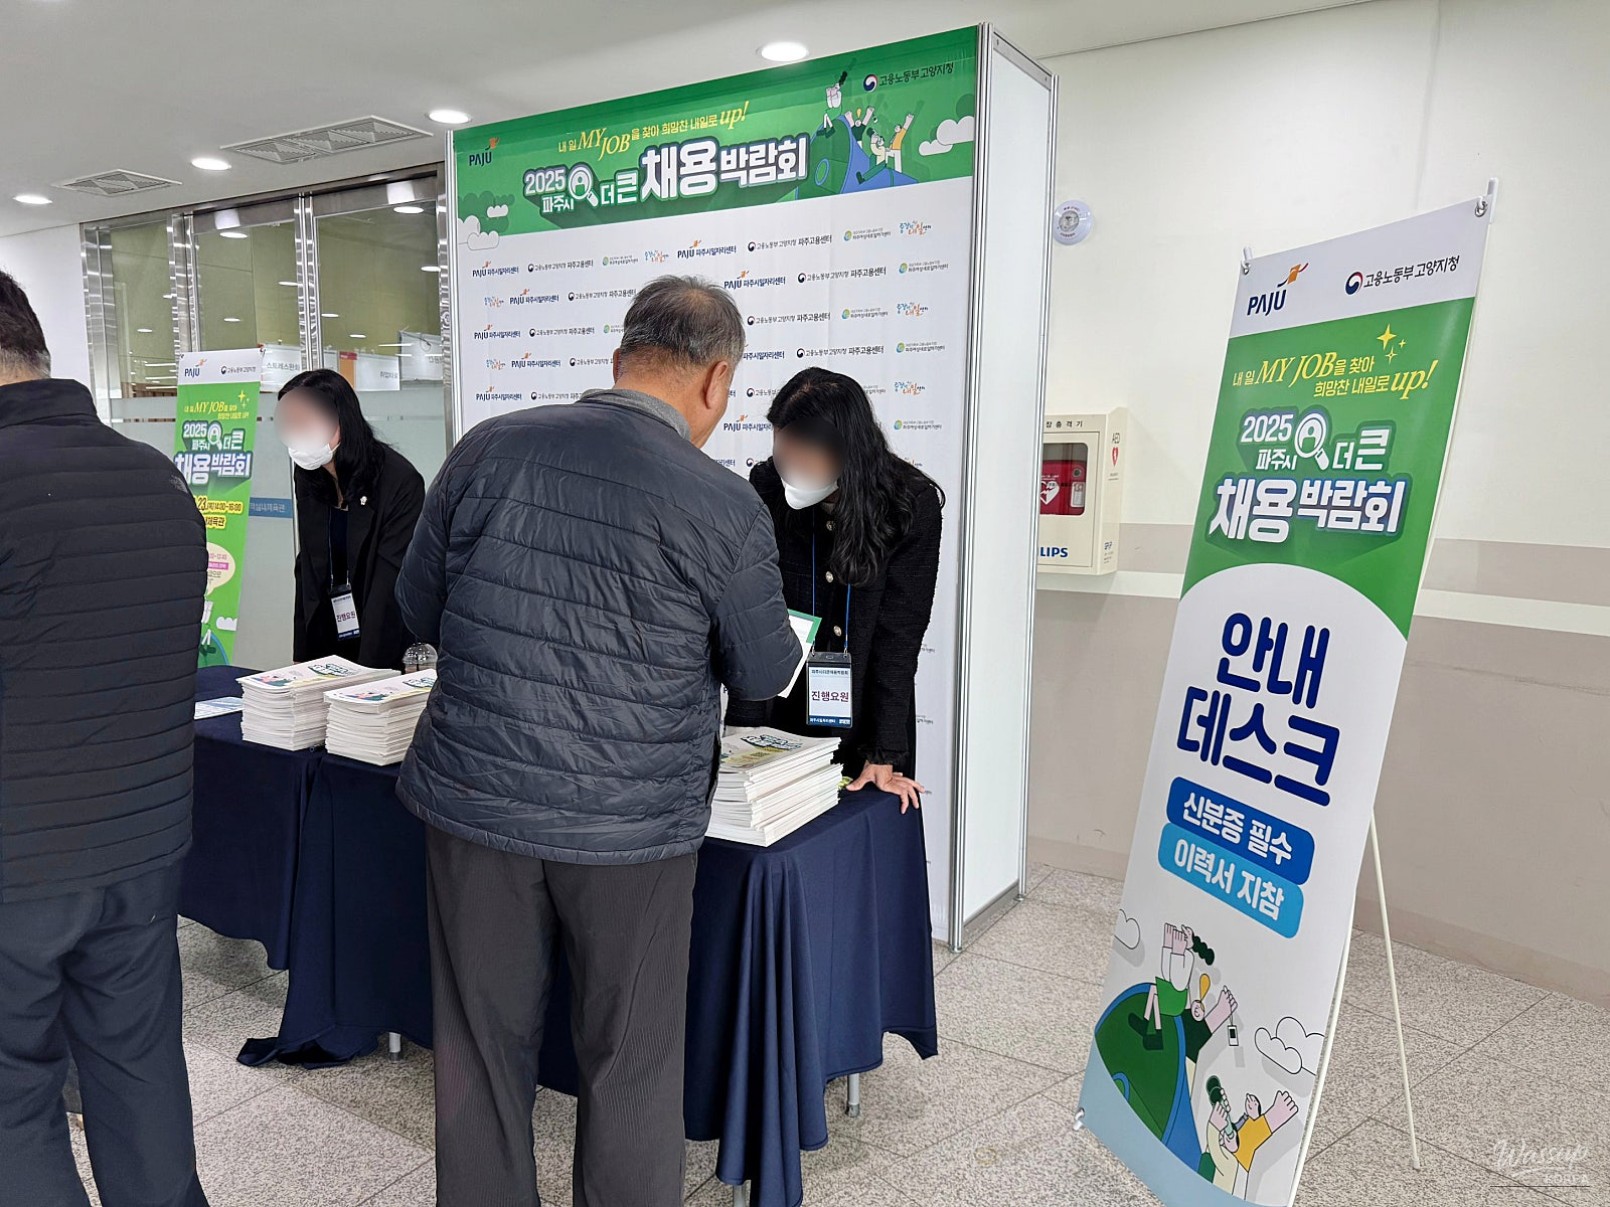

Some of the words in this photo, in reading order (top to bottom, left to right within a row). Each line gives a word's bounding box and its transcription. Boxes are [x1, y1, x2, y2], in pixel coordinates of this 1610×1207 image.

[879, 68, 919, 87] 고용노동부
[920, 61, 954, 79] 고양지청
[558, 141, 567, 153] 내
[578, 128, 606, 150] MY
[642, 124, 660, 138] 찾아
[662, 118, 688, 135] 희망찬
[690, 114, 718, 130] 내일로
[719, 100, 749, 130] up!
[469, 151, 493, 167] PAJU
[525, 169, 566, 195] 2025
[542, 195, 574, 213] 파주시
[677, 250, 695, 259] PAJU
[472, 268, 487, 277] PAJU
[1364, 266, 1415, 288] 고용노동부
[1415, 254, 1460, 279] 고양지청
[724, 280, 743, 289] PAJU
[509, 296, 525, 305] PAJU
[1247, 288, 1287, 316] PAJU
[796, 312, 831, 322] 파주고용센터
[474, 331, 489, 340] PAJU
[848, 345, 884, 355] 파주고용센터
[184, 367, 200, 377] PAJU
[511, 360, 526, 369] PAJU
[1232, 371, 1244, 387] 내
[1245, 370, 1256, 385] 일
[1255, 356, 1296, 384] MY
[1288, 352, 1347, 387] JOB을
[1348, 356, 1375, 374] 찾아
[1313, 380, 1350, 398] 희망찬
[1351, 375, 1389, 394] 내일로
[1390, 360, 1439, 400] up!
[476, 393, 490, 401] PAJU
[194, 401, 209, 412] MY
[183, 422, 208, 438] 2025
[723, 422, 741, 432] PAJU
[1241, 413, 1294, 443] 2025
[1255, 448, 1298, 470] 파주시
[1332, 442, 1352, 470] 더
[1354, 428, 1390, 470] 큰
[1040, 546, 1068, 558] LIPS
[1217, 612, 1330, 709] 안내
[811, 690, 849, 703] 진행요원
[1177, 686, 1340, 807] 데스크
[1183, 792, 1245, 844] 신분증
[1248, 818, 1292, 865] 필수
[1174, 838, 1236, 894] 이력서
[1237, 873, 1285, 921] 지참
